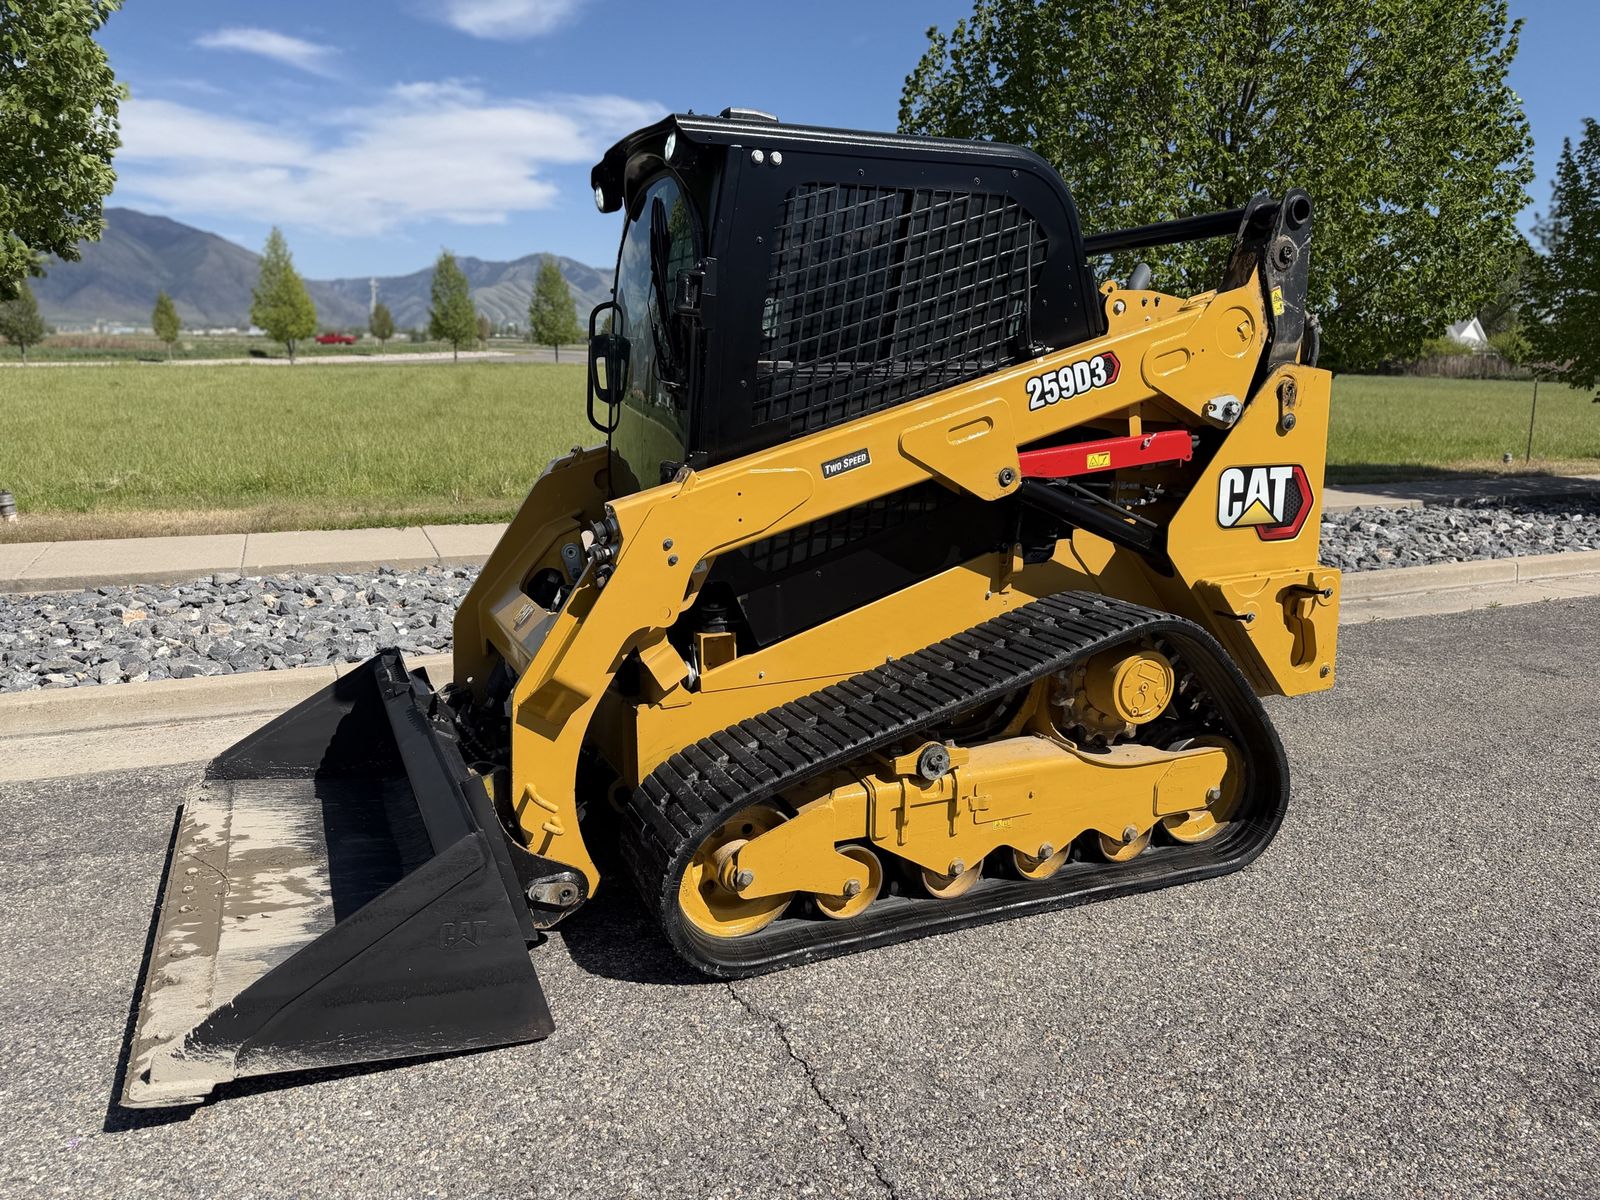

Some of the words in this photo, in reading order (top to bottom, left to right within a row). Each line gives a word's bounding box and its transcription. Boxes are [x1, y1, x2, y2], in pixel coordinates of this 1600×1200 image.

[1026, 355, 1107, 411] 259D3
[824, 462, 842, 475] TWO
[843, 453, 867, 468] SPEED
[1218, 466, 1293, 527] CAT
[440, 920, 489, 950] CAT
